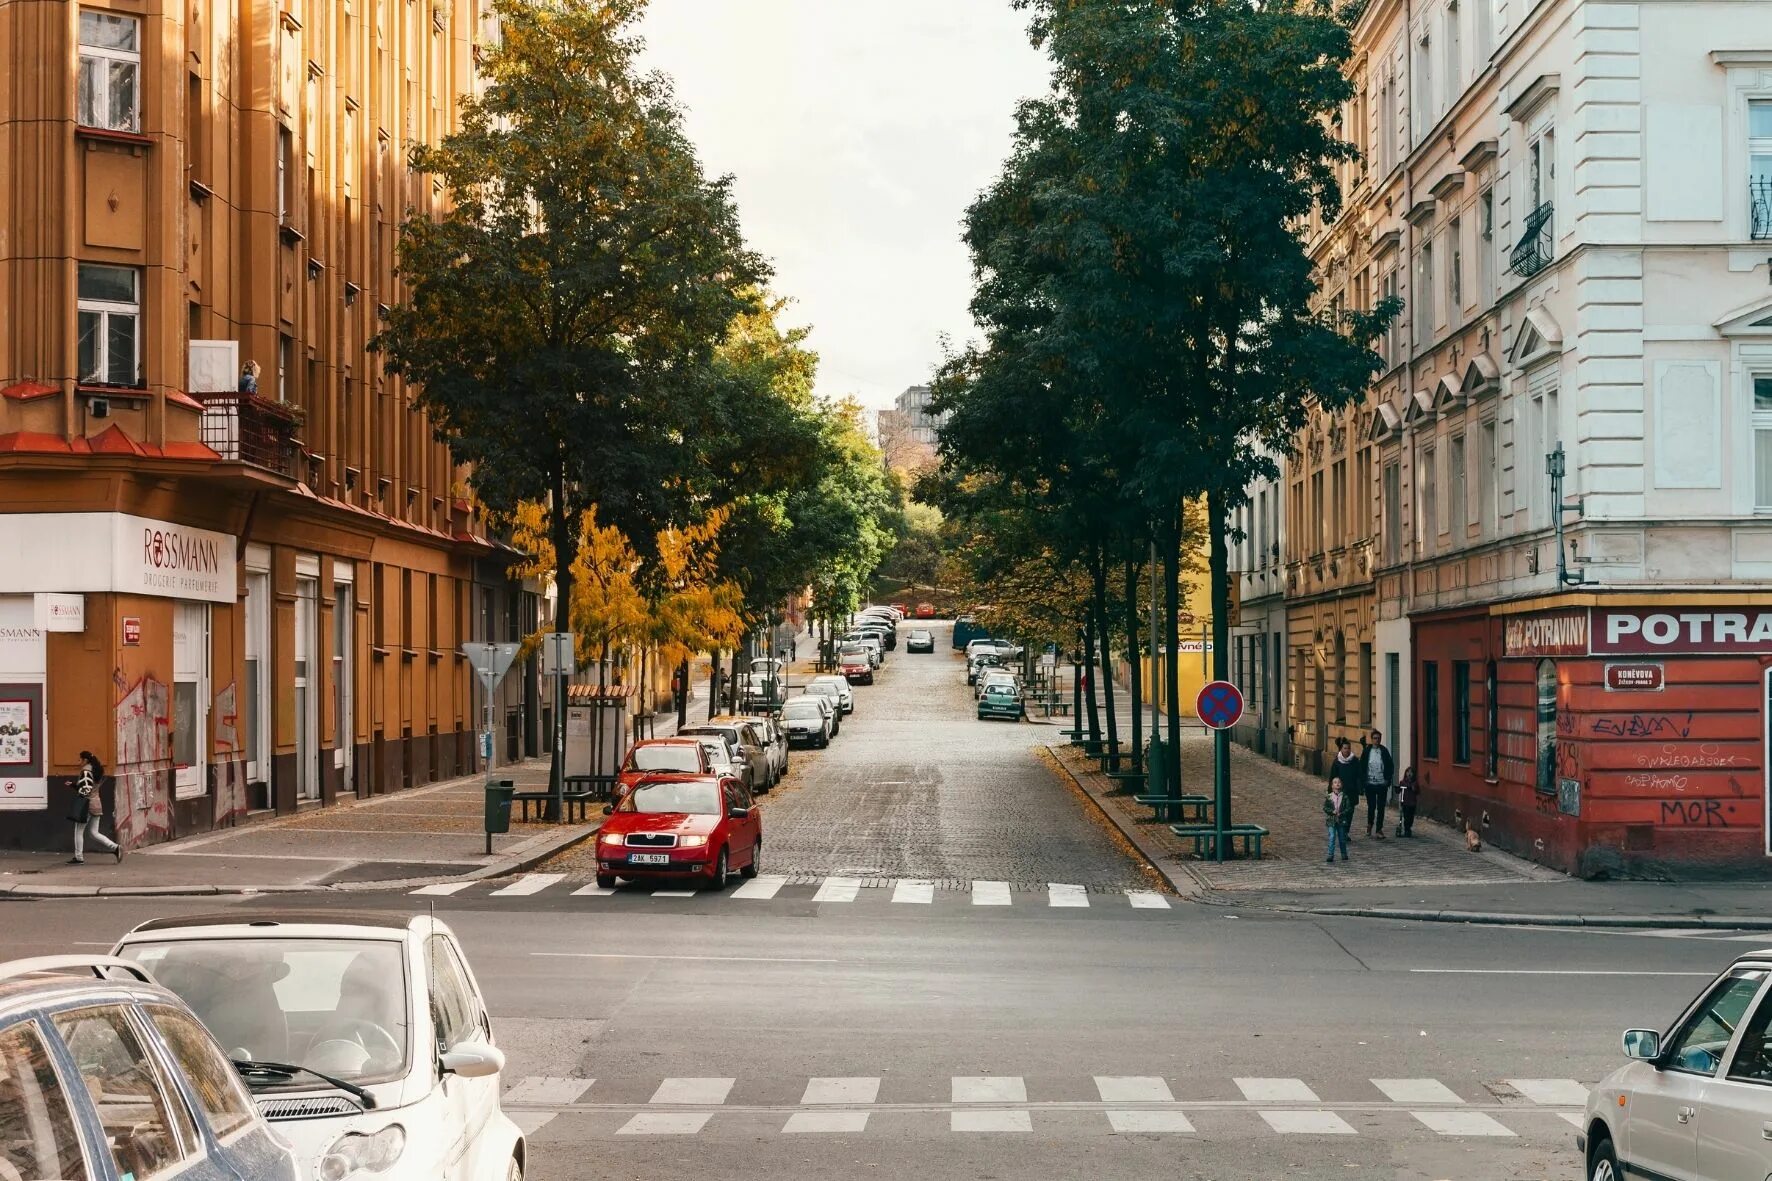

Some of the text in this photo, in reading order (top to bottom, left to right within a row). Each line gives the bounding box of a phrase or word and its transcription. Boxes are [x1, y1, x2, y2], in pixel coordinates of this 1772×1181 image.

[144, 528, 218, 574] ROSSMANN
[144, 573, 176, 588] DROGERIE
[1525, 616, 1586, 647] POTRAVINY
